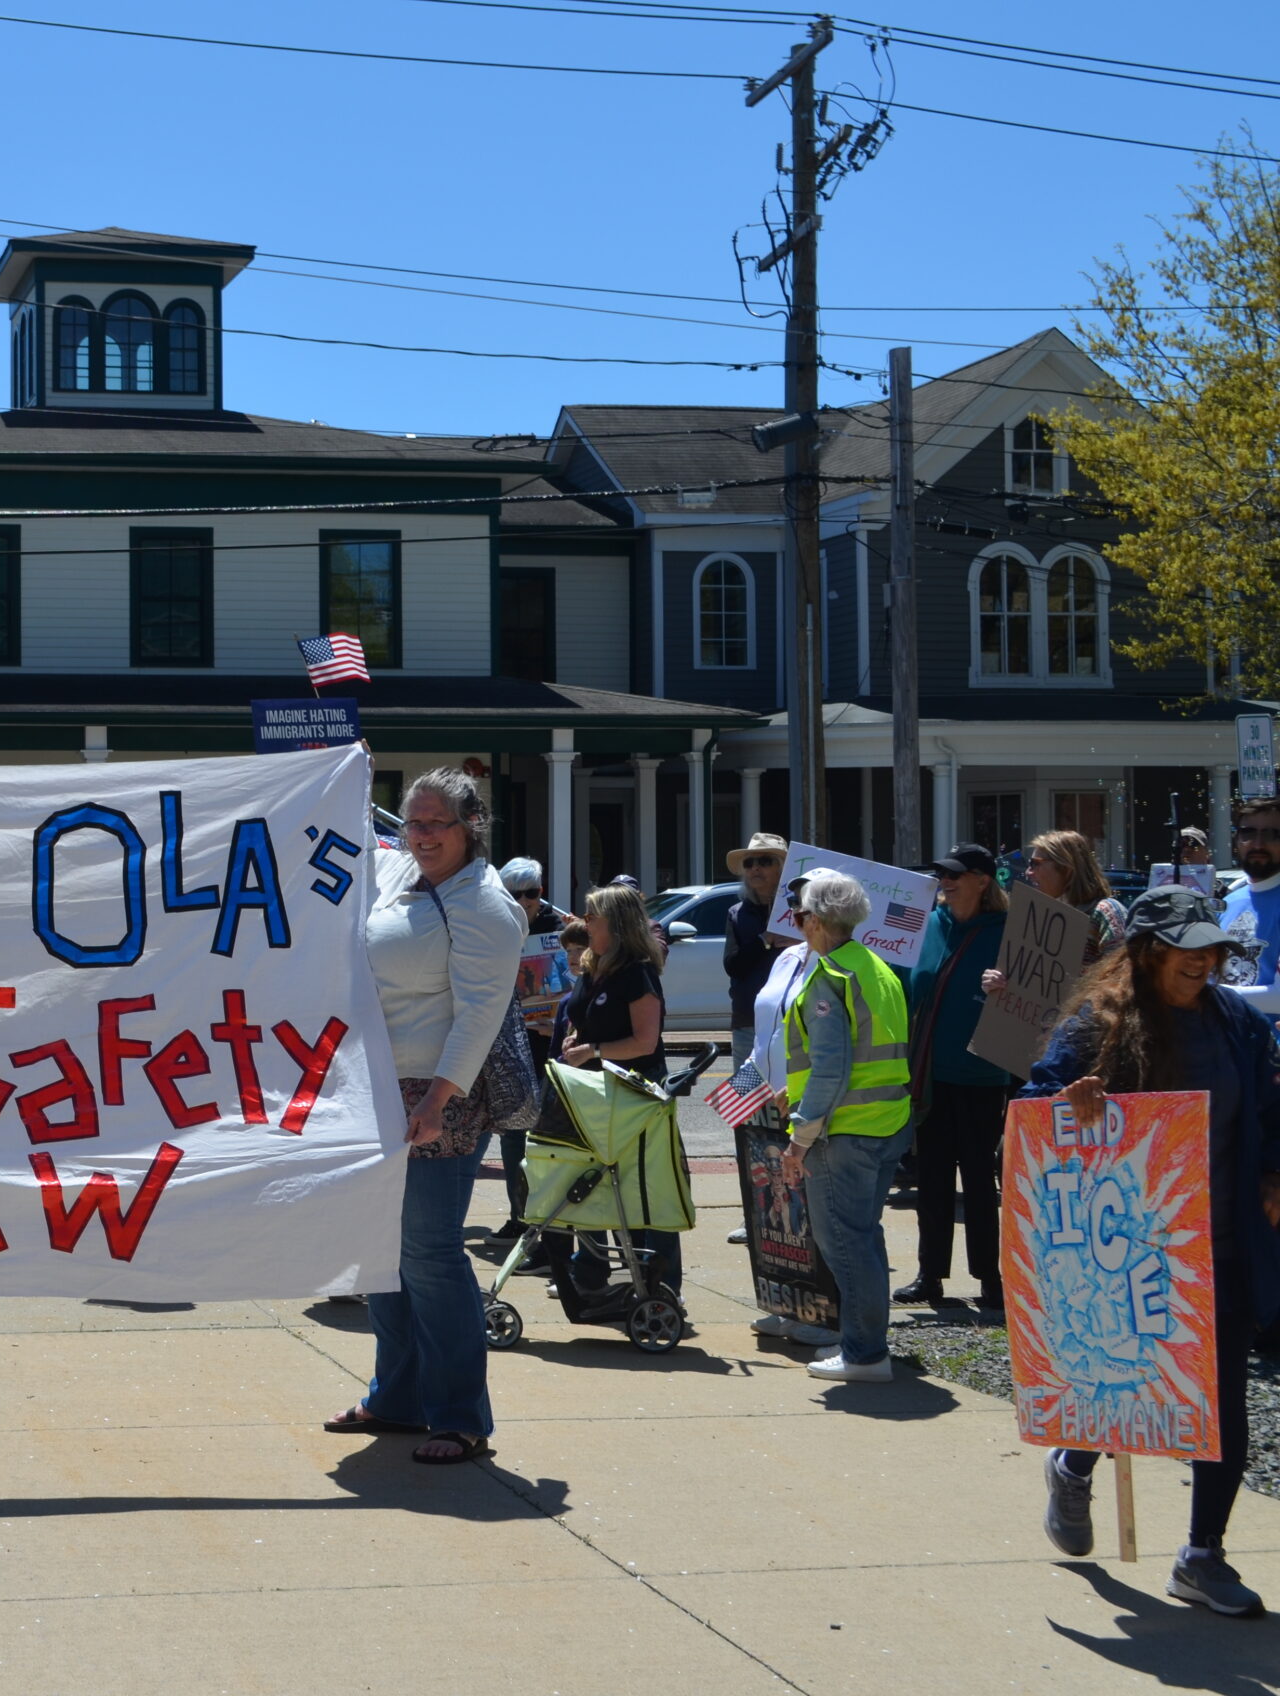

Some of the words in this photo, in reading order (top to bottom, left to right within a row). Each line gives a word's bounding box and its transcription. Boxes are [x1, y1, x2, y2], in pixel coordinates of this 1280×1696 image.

[261, 725, 324, 739] IMMIGRANTS
[327, 724, 355, 737] MORE
[266, 710, 308, 723] IMAGINE
[310, 709, 347, 722] HATING
[1250, 725, 1260, 740] 30
[862, 929, 915, 955] Great!
[1023, 900, 1066, 957] NO
[1006, 941, 1065, 1004] WAR
[995, 986, 1042, 1026] PEACE
[761, 1227, 768, 1240] IF
[769, 1229, 782, 1243] YOU
[1045, 1170, 1169, 1337] ICE
[758, 1276, 829, 1323] RESIST
[1016, 1384, 1047, 1436] BE
[1060, 1391, 1209, 1452] HUMANE!
